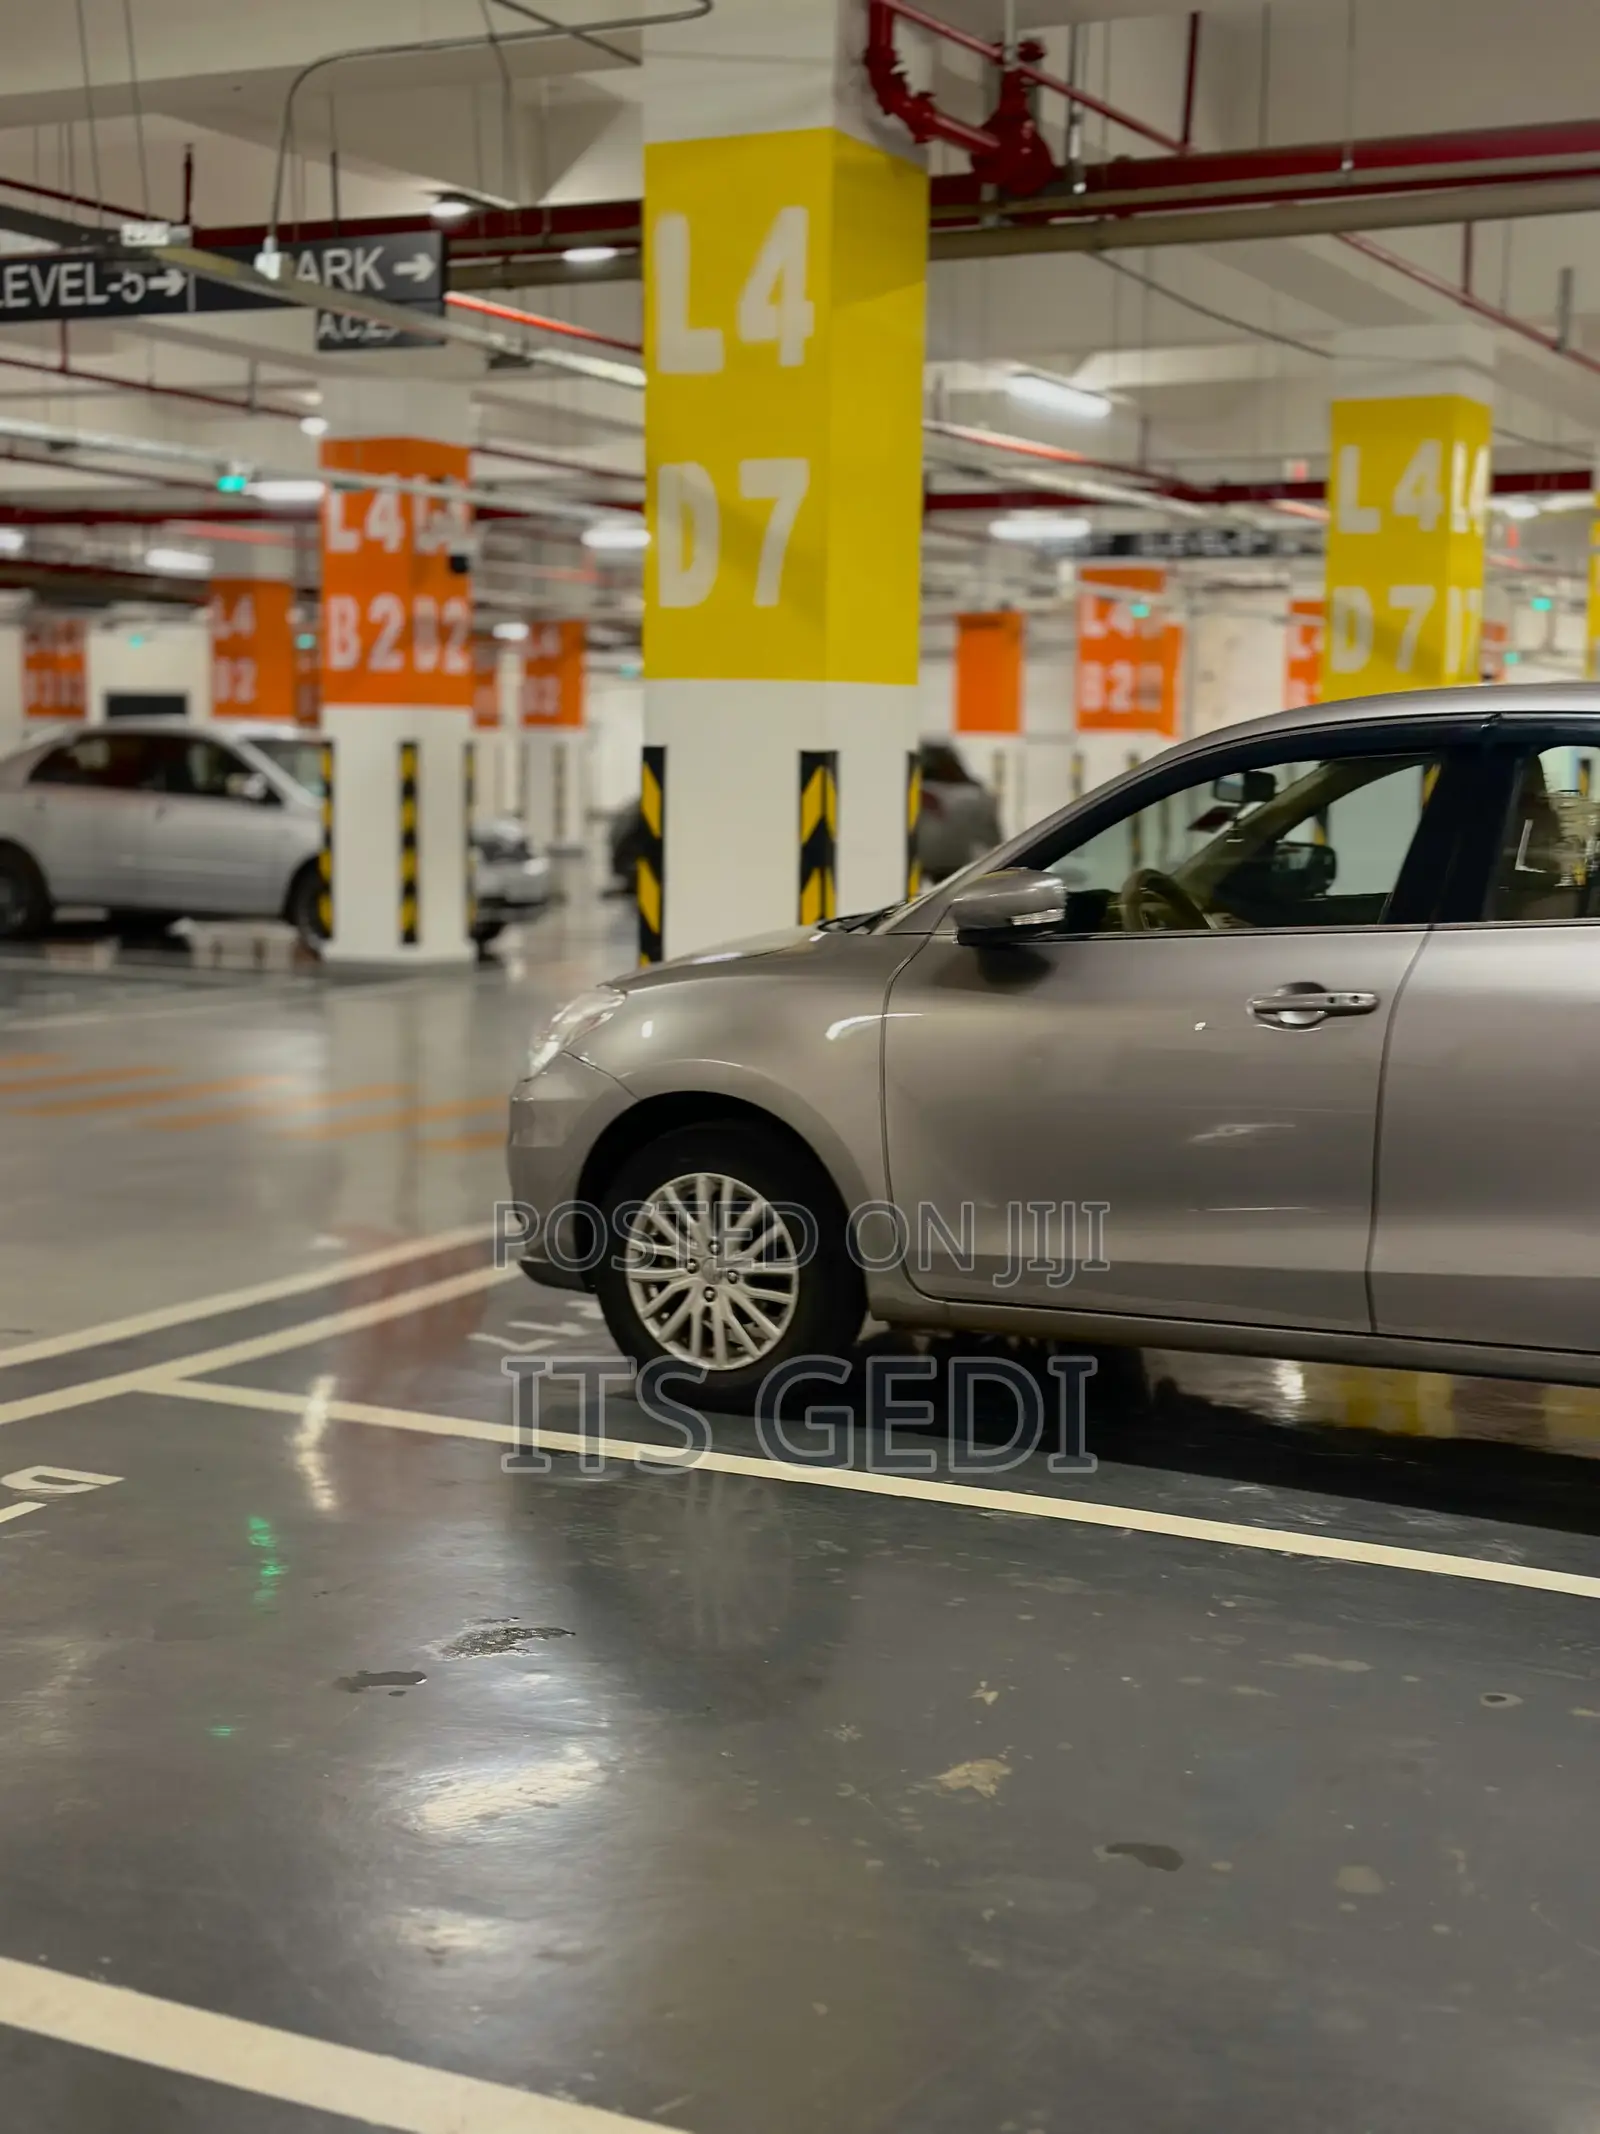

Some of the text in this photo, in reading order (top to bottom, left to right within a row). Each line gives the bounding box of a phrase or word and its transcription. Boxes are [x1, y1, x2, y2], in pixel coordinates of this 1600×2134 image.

[653, 206, 815, 375] L4
[328, 478, 404, 554] L4
[1336, 438, 1445, 534] L4
[657, 457, 811, 609] D7
[330, 593, 405, 672] B2
[1330, 584, 1437, 674] D7
